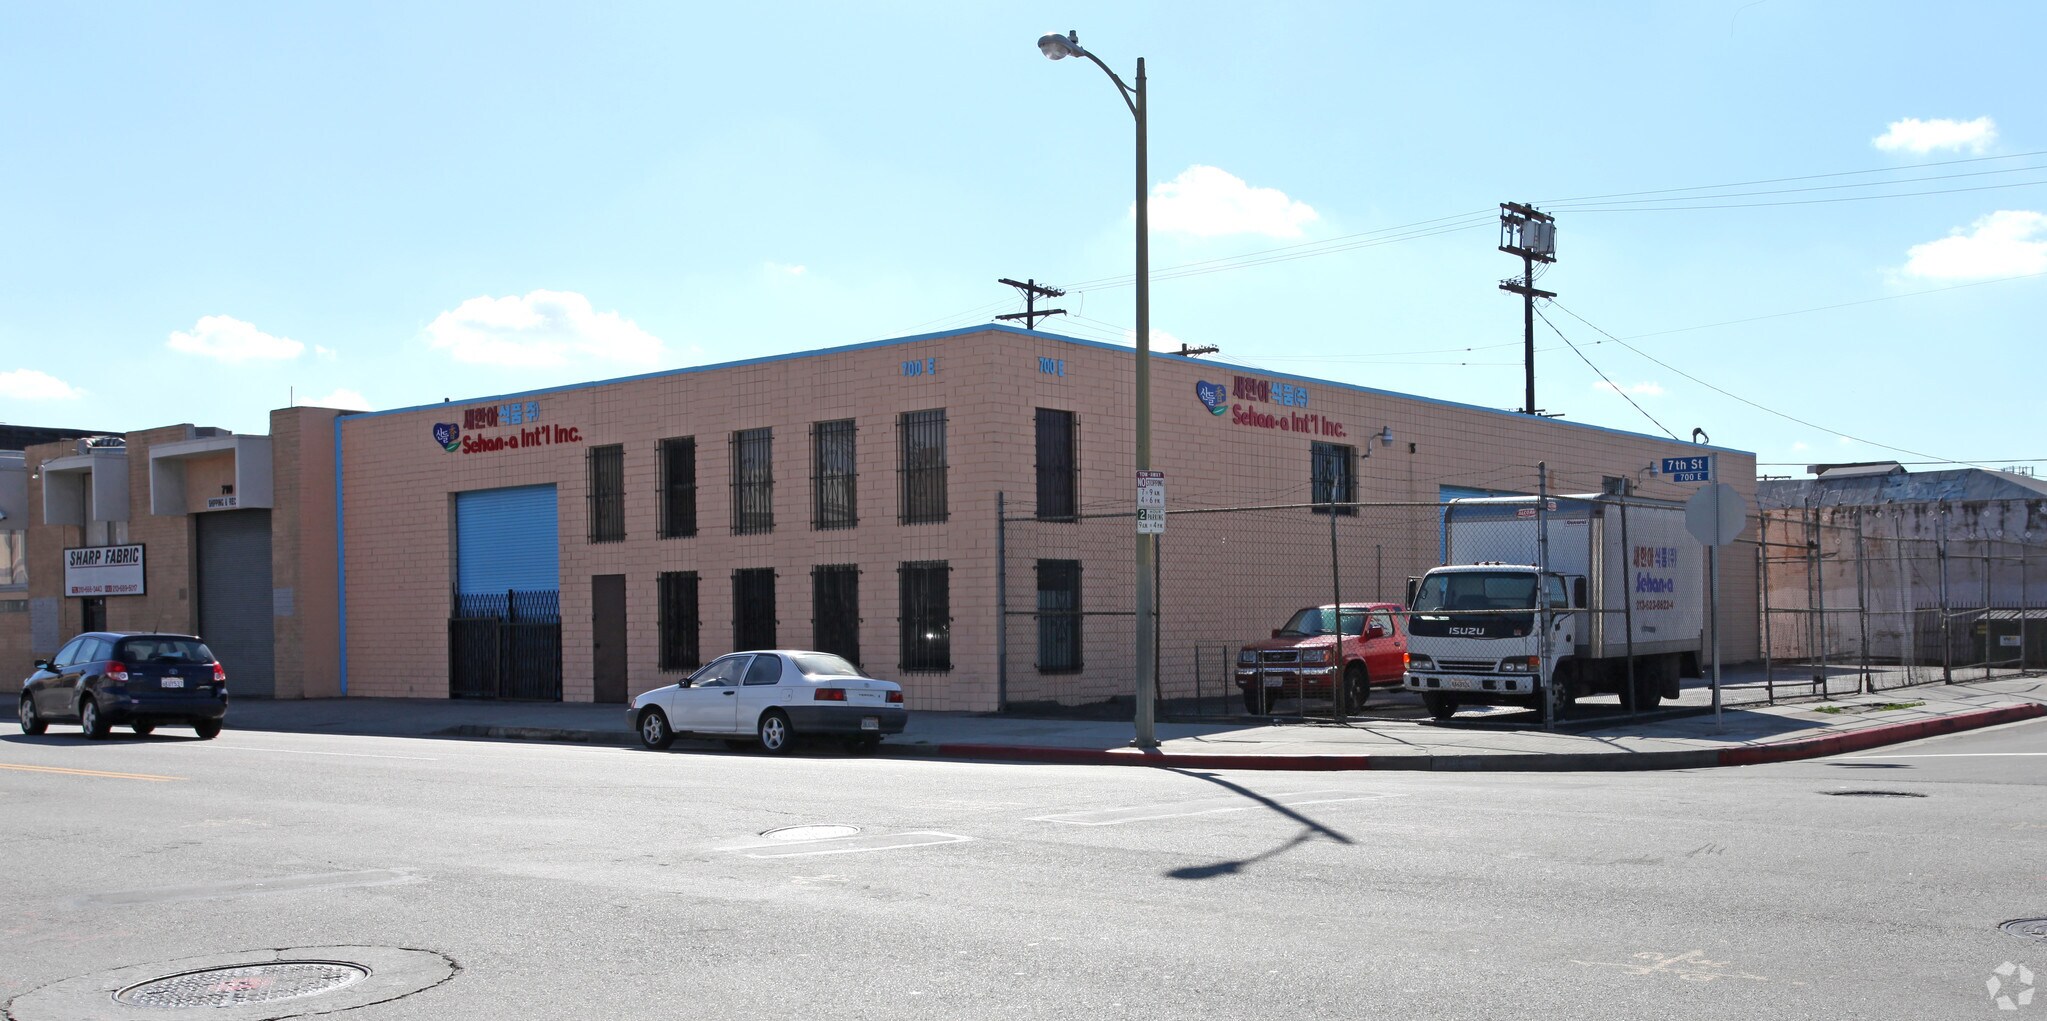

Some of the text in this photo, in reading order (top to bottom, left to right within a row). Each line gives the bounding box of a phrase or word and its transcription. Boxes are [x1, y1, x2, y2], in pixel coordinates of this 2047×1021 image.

[902, 357, 936, 376] 700 E
[1038, 356, 1064, 377] 700 E
[1322, 416, 1347, 437] Inc.
[554, 424, 583, 444] Inc.
[1668, 459, 1703, 470] 7th St
[1137, 478, 1146, 487] NO
[1680, 473, 1694, 481] 700
[1140, 509, 1146, 520] 2
[70, 548, 139, 566] SHARP FABRIC
[1449, 627, 1485, 635] ISUZU
